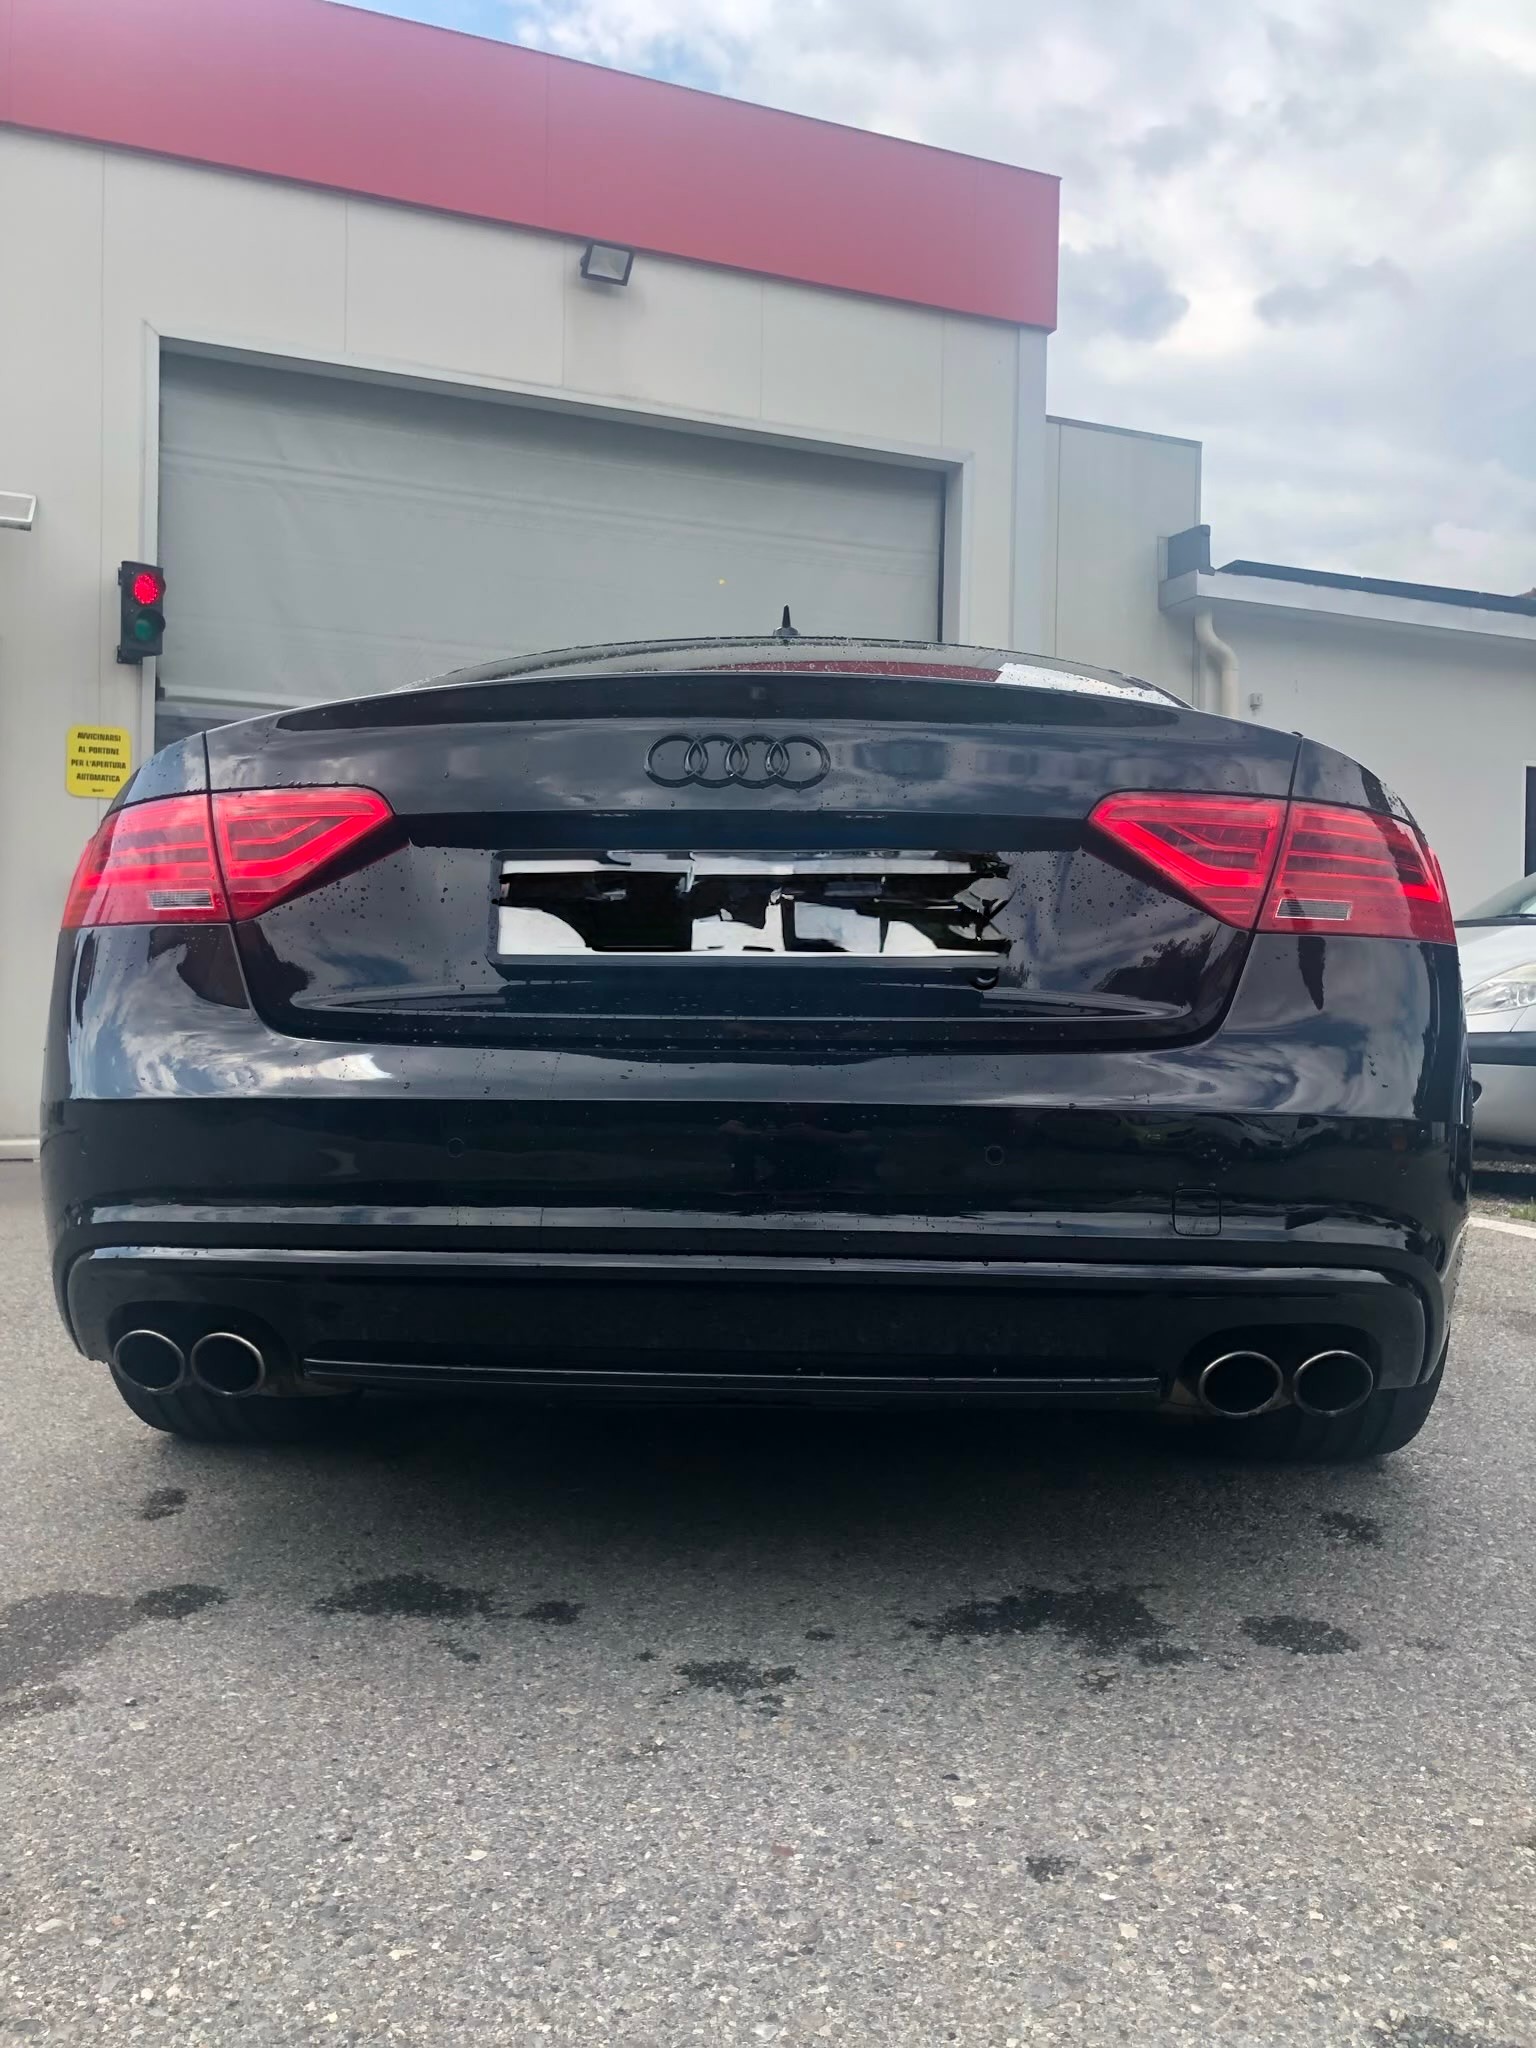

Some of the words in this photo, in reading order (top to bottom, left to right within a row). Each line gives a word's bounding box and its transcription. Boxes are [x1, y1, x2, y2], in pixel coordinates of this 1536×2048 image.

[77, 732, 121, 742] AVVICINARSI
[89, 746, 119, 755] PORTONE
[71, 759, 84, 767] PER
[86, 760, 126, 769] L'APERTURA
[77, 773, 120, 782] AUTOMATICA
